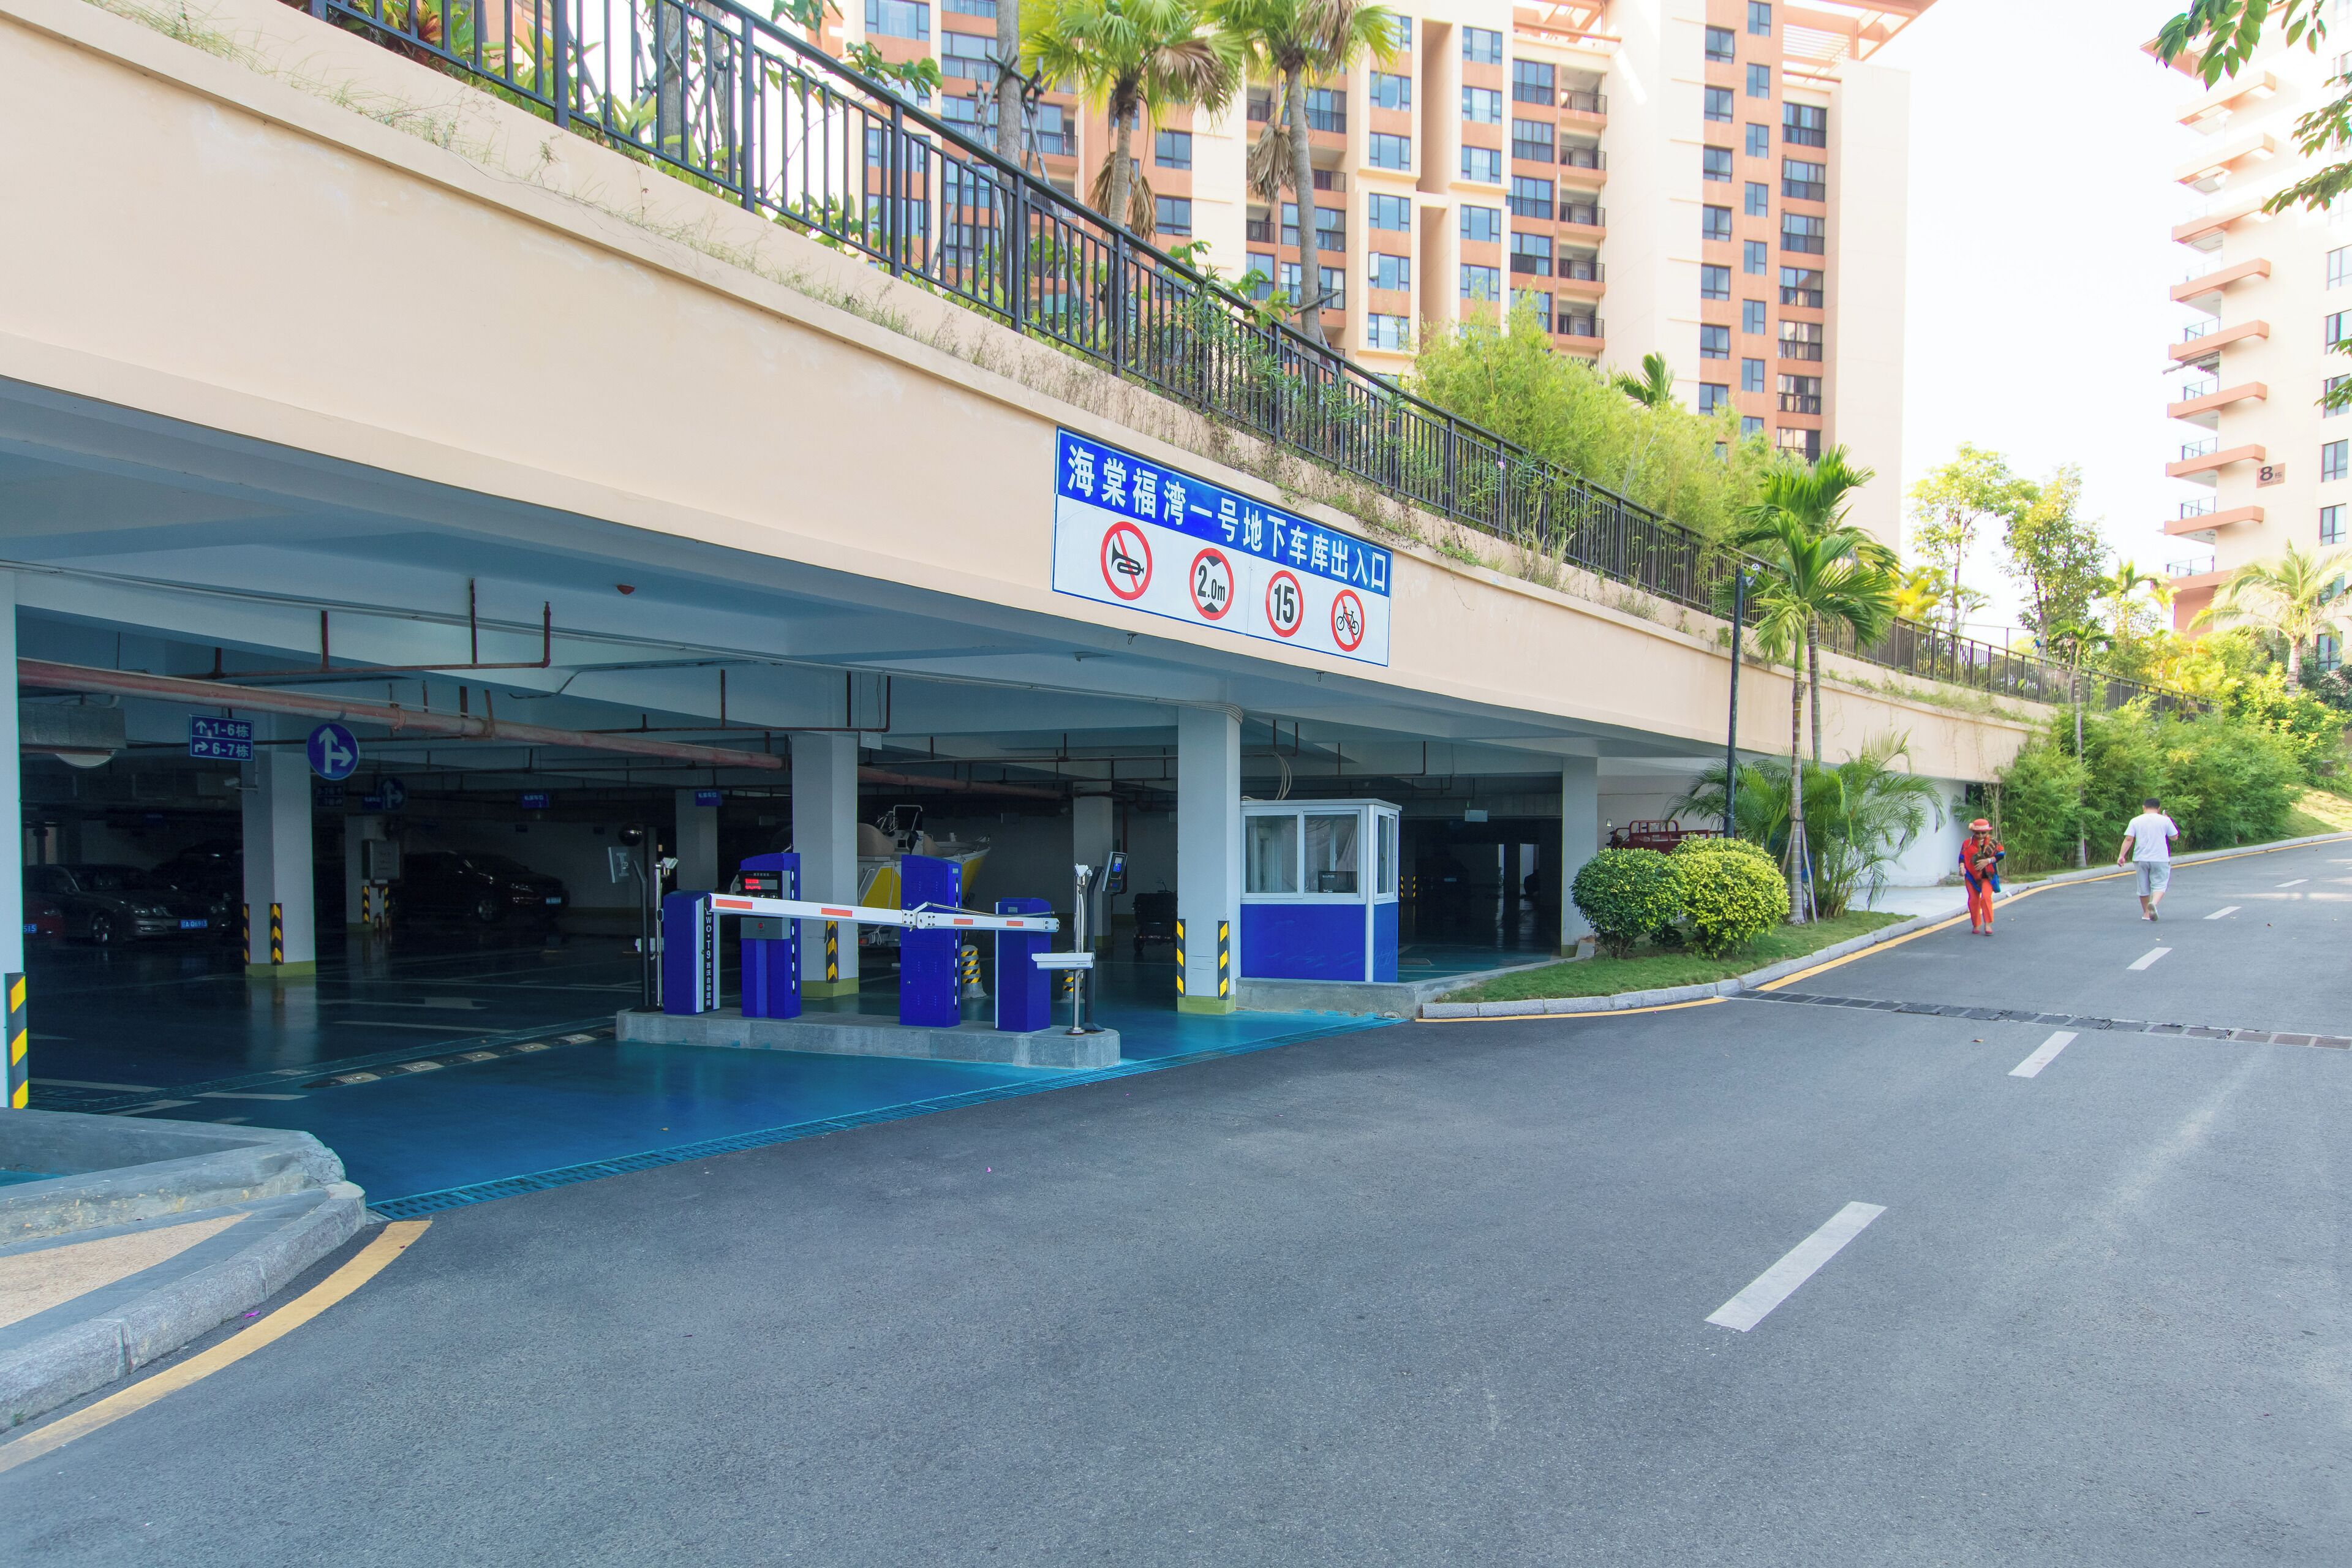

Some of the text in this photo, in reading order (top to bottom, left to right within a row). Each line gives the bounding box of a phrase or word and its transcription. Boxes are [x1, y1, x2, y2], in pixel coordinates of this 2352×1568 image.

[1068, 444, 1386, 591] 海棠福湾一号地下车库出入口
[1197, 565, 1225, 602] 2.0m
[1274, 584, 1294, 624] 15
[213, 722, 249, 738] 1-6栋
[212, 742, 249, 758] 6-7栋
